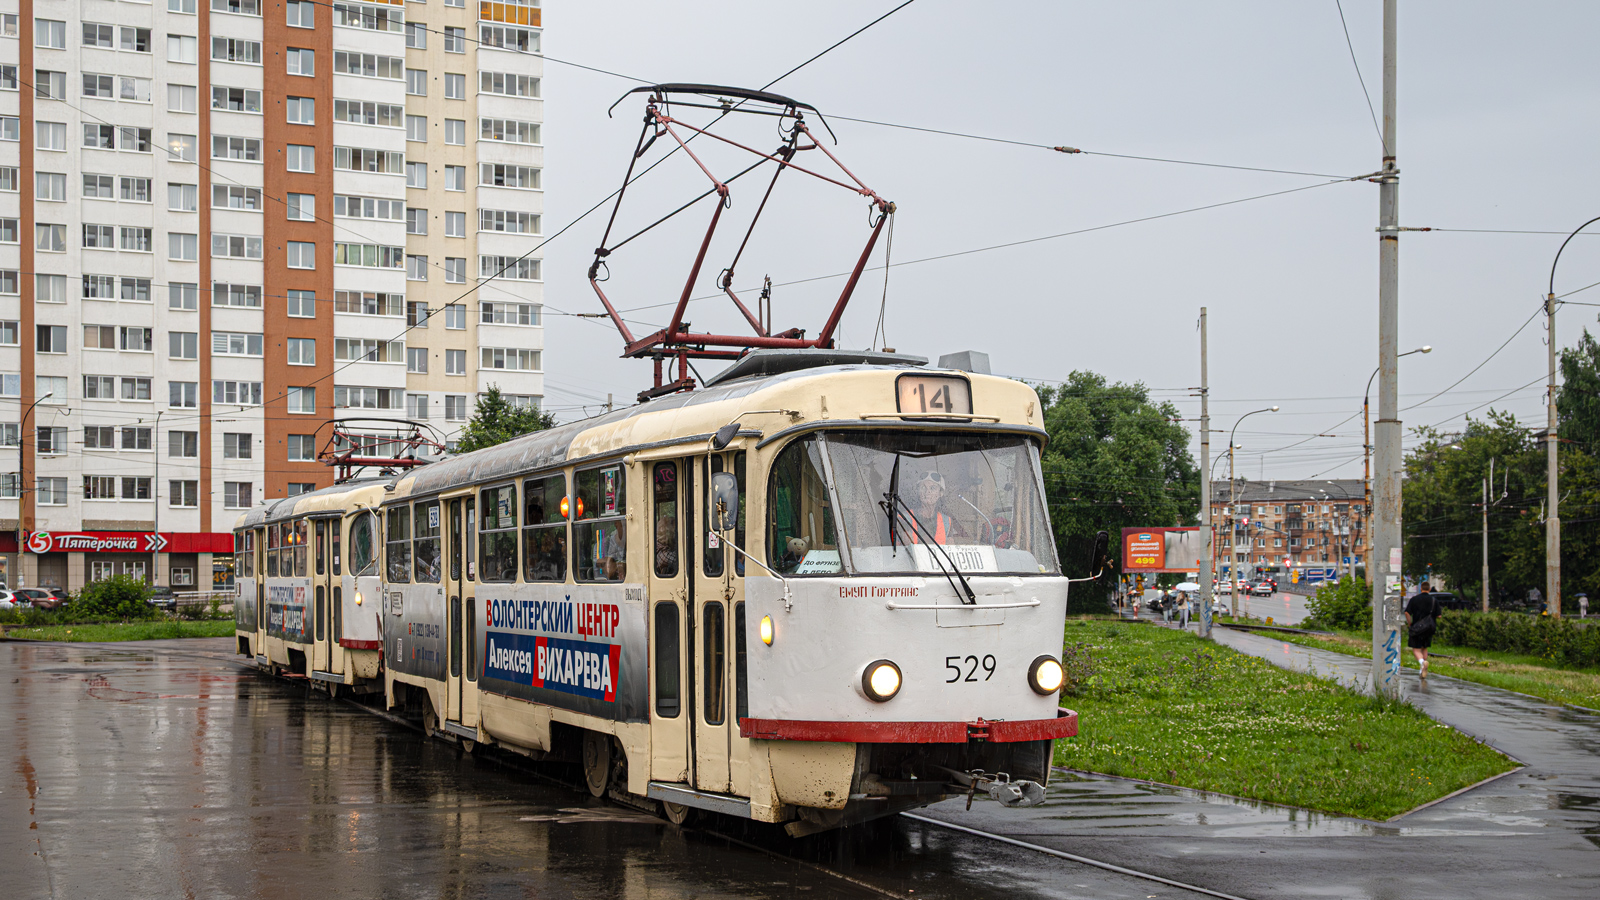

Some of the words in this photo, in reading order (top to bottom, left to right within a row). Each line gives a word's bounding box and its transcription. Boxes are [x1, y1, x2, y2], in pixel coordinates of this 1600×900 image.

[913, 383, 953, 419] 14
[55, 535, 138, 552] Пятёрочка
[839, 587, 868, 598] ЕМУП
[486, 594, 573, 634] ВОЛОНТЕРСКИЙ
[577, 602, 619, 641] ЦЕНТР
[489, 638, 532, 675] Алексея
[537, 645, 612, 693] ВИХАРЕВА
[945, 654, 997, 683] 529
